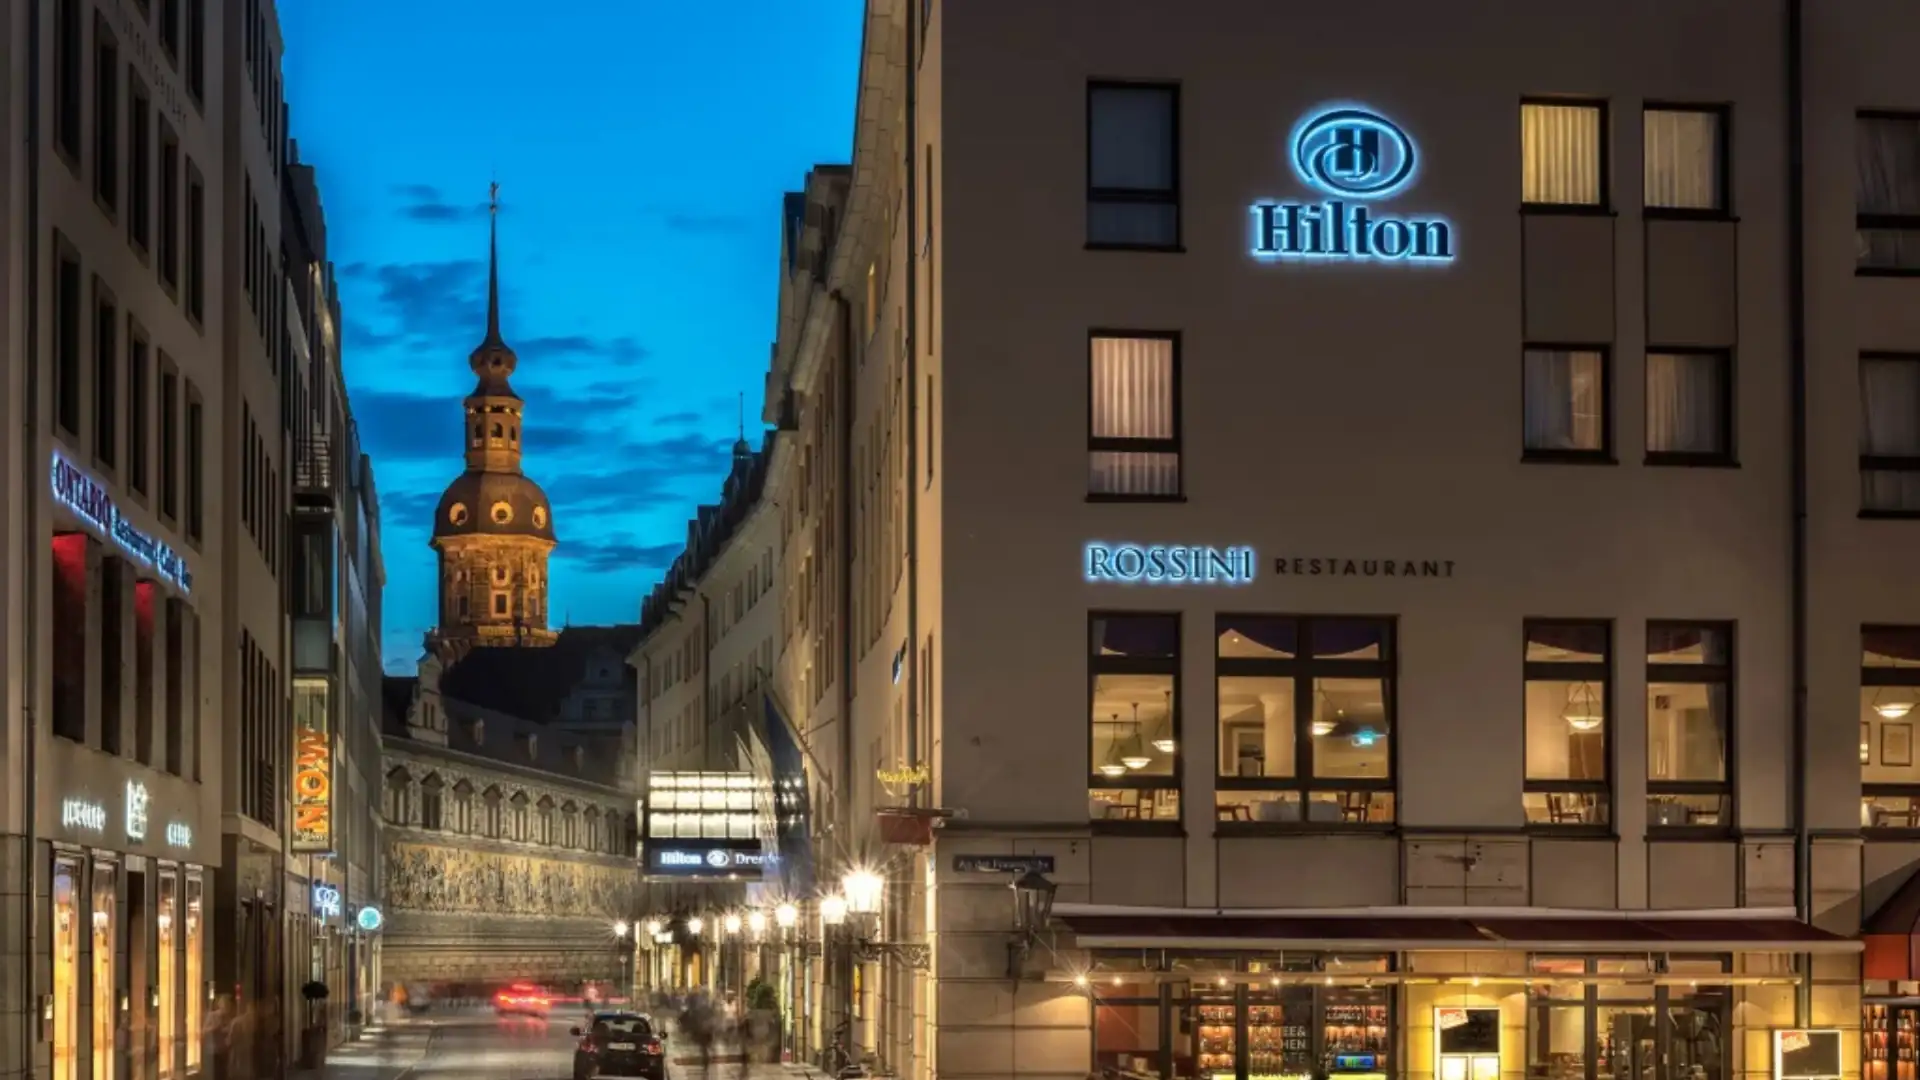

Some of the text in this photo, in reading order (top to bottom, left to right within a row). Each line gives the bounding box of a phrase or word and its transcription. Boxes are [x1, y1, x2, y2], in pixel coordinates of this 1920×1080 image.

[1252, 201, 1453, 258] Hilton
[1087, 546, 1455, 580] ROSSINI RESTAURANT
[660, 850, 702, 865] Hilton
